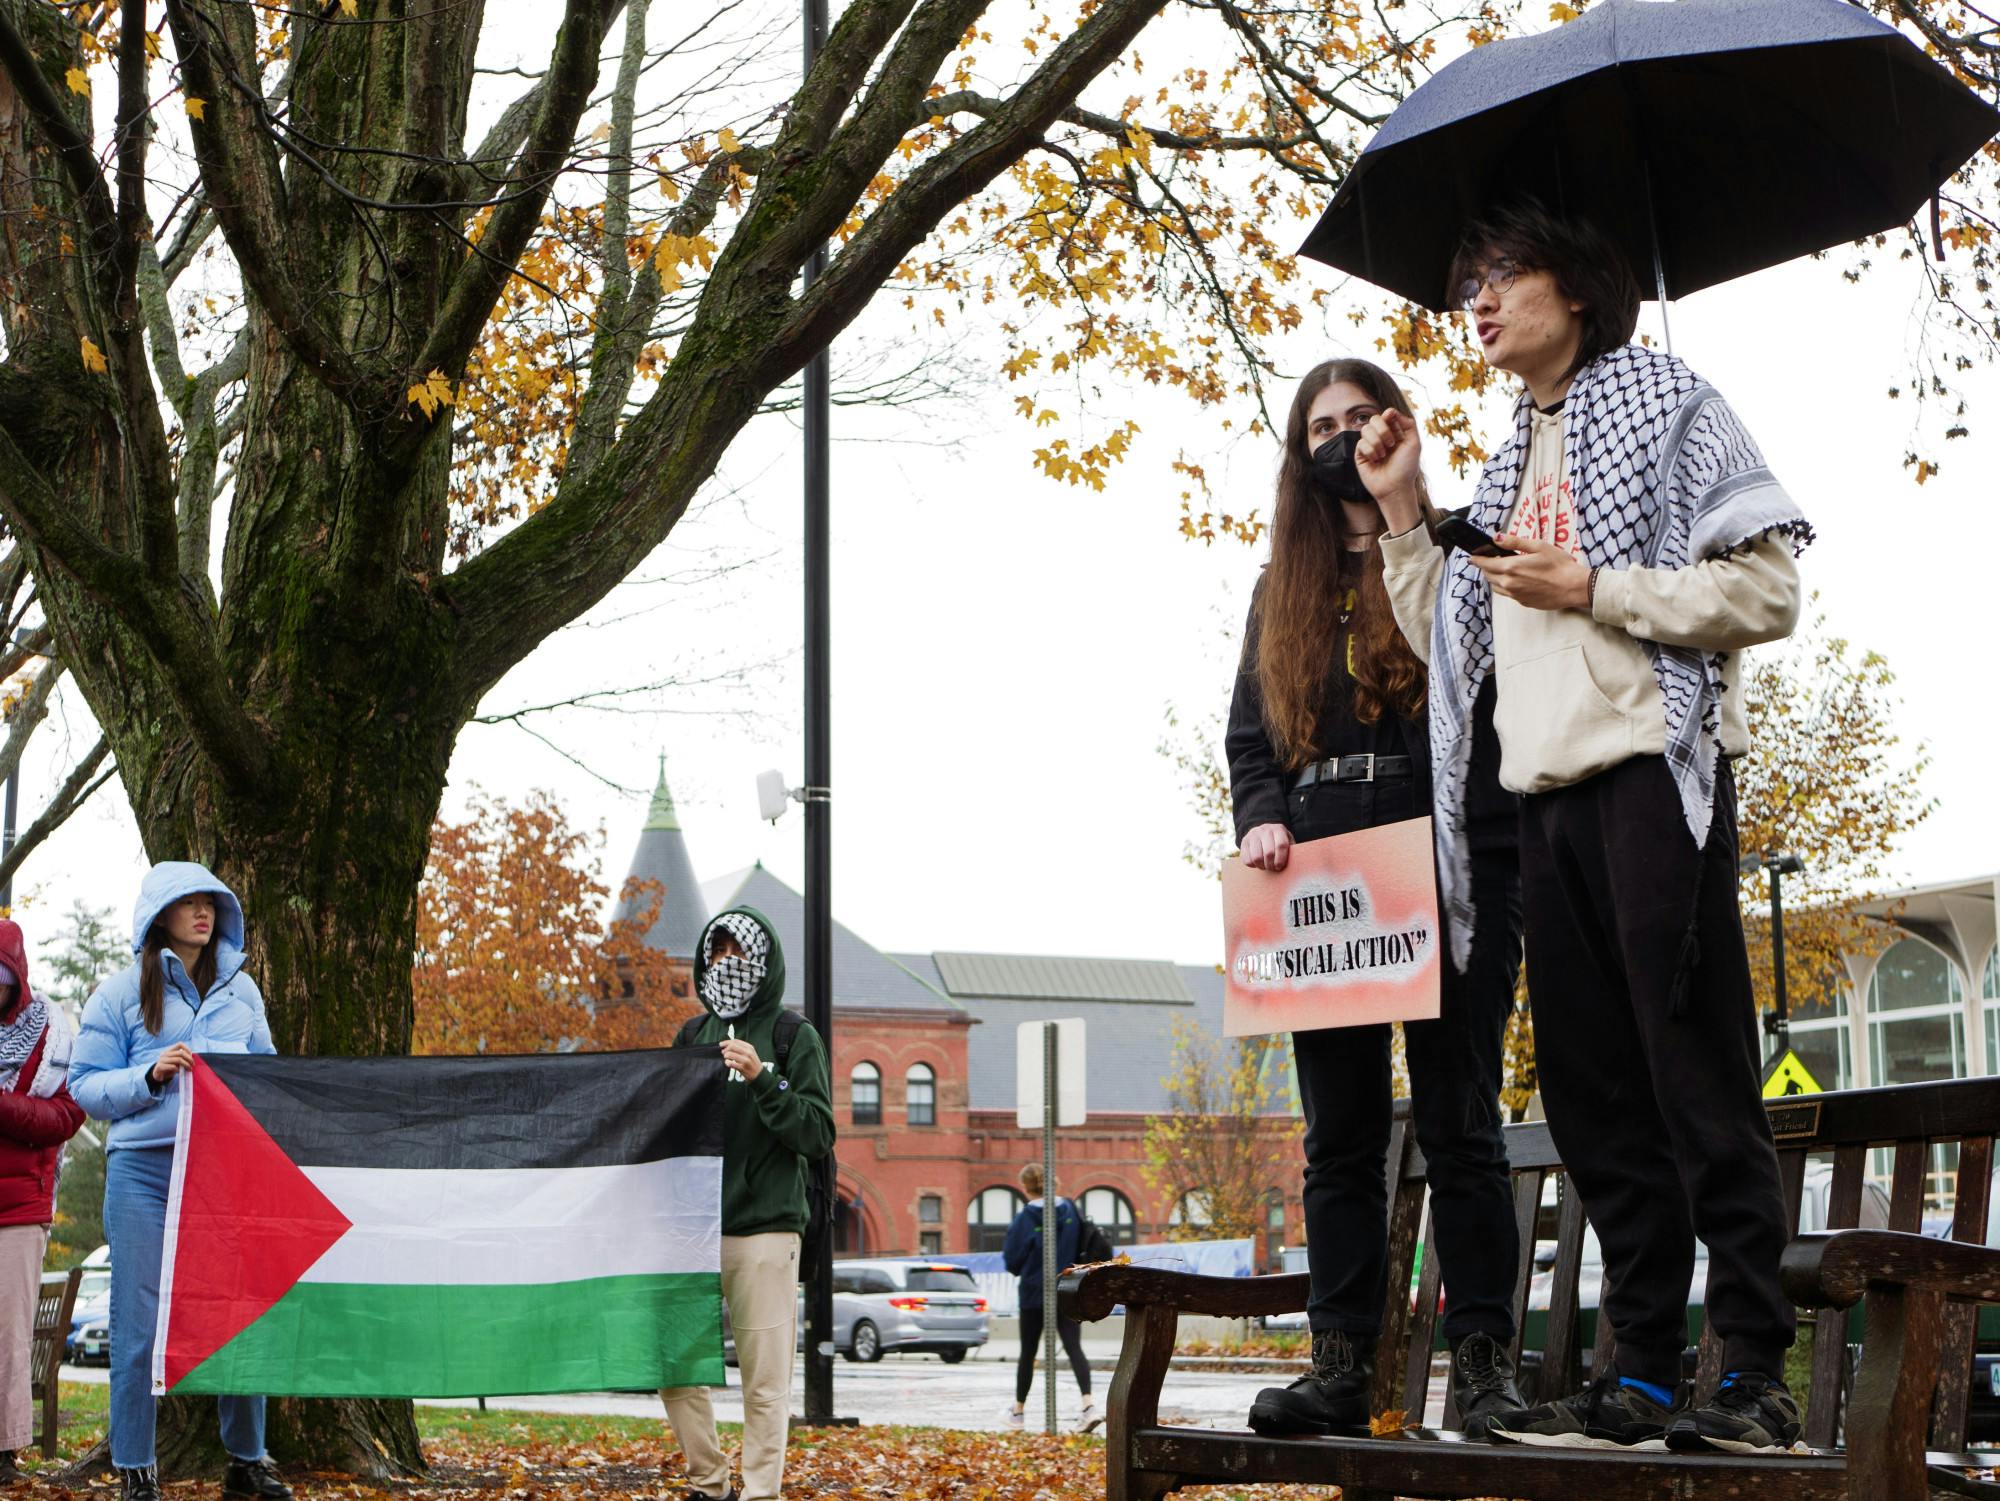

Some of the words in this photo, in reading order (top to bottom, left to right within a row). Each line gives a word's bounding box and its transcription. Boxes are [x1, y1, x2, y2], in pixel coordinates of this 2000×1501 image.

[1290, 892, 1335, 928] THIS
[1341, 887, 1361, 920] IS
[1342, 929, 1427, 970] ACTION”
